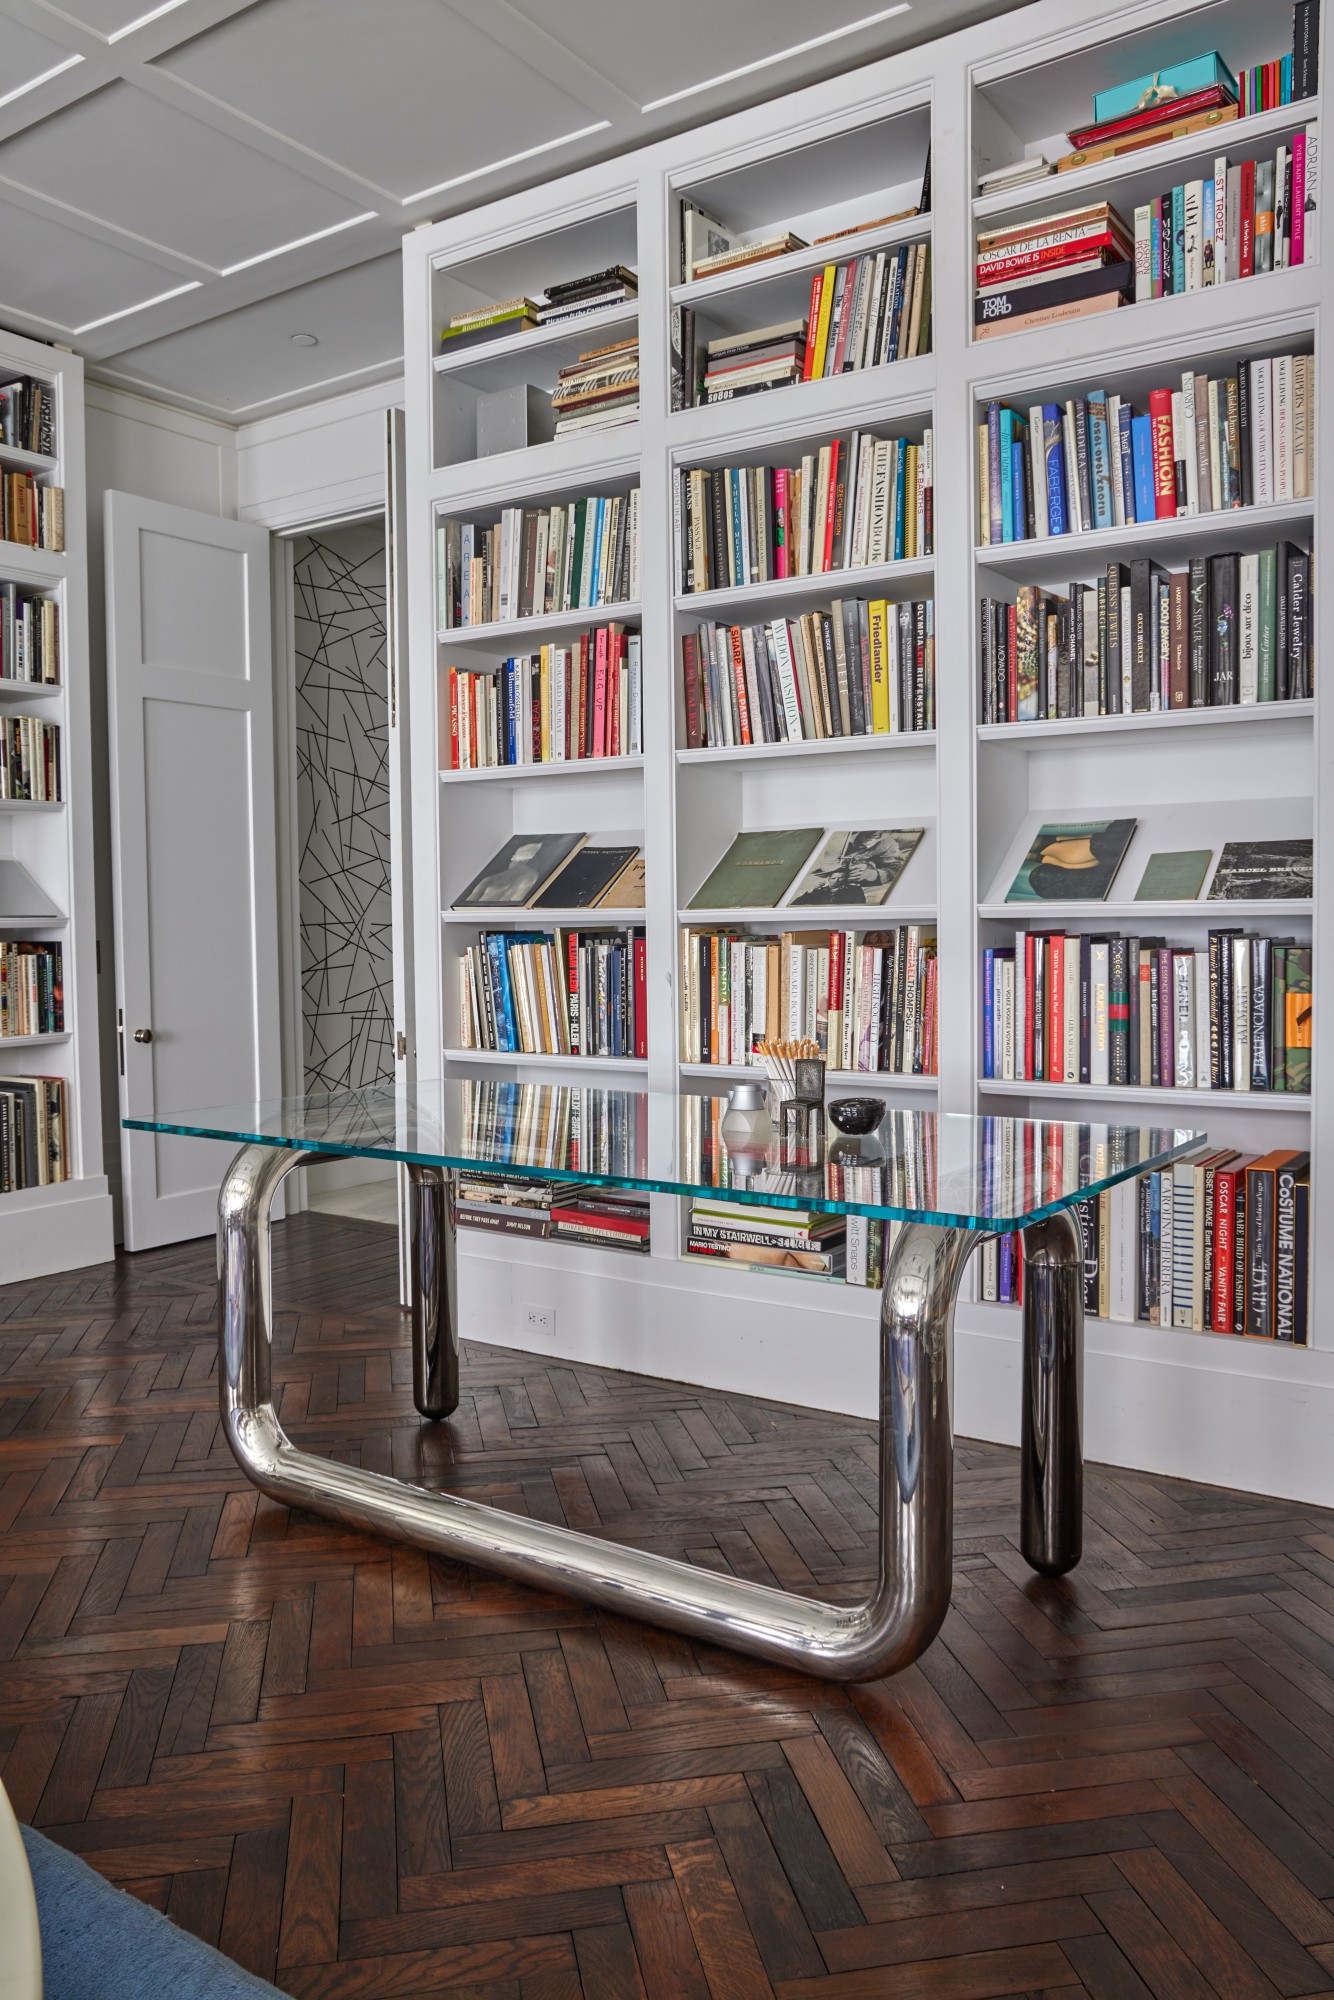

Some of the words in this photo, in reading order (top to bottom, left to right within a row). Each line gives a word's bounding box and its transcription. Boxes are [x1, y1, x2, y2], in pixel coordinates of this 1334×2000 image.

[1306, 136, 1318, 192] ADRIAN
[1216, 178, 1224, 195] ST.
[1216, 196, 1224, 242] TROPEZ
[979, 261, 1005, 275] DAVID
[1005, 255, 1032, 269] BOWIE
[1032, 252, 1040, 262] IS
[1040, 245, 1066, 259] INSIDE
[982, 245, 1017, 262] OSCAR
[1019, 240, 1034, 253] DE
[1036, 235, 1049, 247] LA
[1052, 228, 1087, 244] RENTA
[1142, 239, 1150, 275] FASHION
[843, 282, 851, 303] Tazio
[893, 268, 903, 309] REVELATION
[982, 295, 1007, 310] TOM
[838, 302, 850, 343] Secchiaroli
[983, 303, 1012, 319] FORD
[1024, 314, 1051, 326] Christian
[1185, 377, 1194, 419] CARVEN
[1295, 358, 1305, 408] HARPER'S
[1033, 416, 1041, 434] Cartier
[1075, 411, 1087, 469] VERDURA
[1111, 425, 1119, 439] ART
[1120, 430, 1131, 455] PIAGET
[1294, 411, 1305, 456] BAZAAR
[878, 444, 887, 470] THE
[1112, 440, 1121, 464] DECO
[1158, 415, 1174, 497] FASHION
[874, 471, 886, 525] FASHION
[1047, 458, 1062, 527] FABERGE
[1097, 477, 1106, 516] BIJOUX
[1113, 466, 1122, 499] JEWELRY
[835, 510, 843, 536] VISION
[716, 528, 724, 581] REVELATIONS
[872, 526, 883, 563] BOOK
[463, 534, 471, 599] AREA
[581, 552, 589, 598] HOLLYWOOD
[1160, 597, 1170, 624] body
[1243, 593, 1252, 615] déco
[1292, 573, 1303, 613] Calder
[1108, 612, 1118, 648] JEWELS
[1192, 607, 1204, 643] SILVER
[1244, 615, 1252, 630] ART
[1290, 615, 1303, 660] Jewelry
[731, 629, 742, 664] SHARP
[872, 614, 883, 684] Friedlander
[1160, 625, 1170, 660] jewelry
[1243, 633, 1254, 660] bijoux
[686, 646, 695, 685] RALPH
[735, 666, 746, 697] NIGEL
[837, 653, 849, 696] SIEFF
[997, 645, 1006, 682] MOVADO
[1213, 671, 1234, 682] JAR
[688, 690, 698, 736] LAUREN
[737, 698, 749, 732] PARRY
[781, 675, 798, 725] FASHION
[916, 667, 924, 731] RIEFENSTAHL
[450, 704, 458, 737] PICASSO
[532, 699, 541, 755] DOISNEAU
[568, 933, 578, 968] WILLIAM
[907, 937, 916, 981] MICHAEL
[569, 970, 578, 993] KLEIN
[720, 966, 728, 1003] INDIA
[791, 950, 799, 999] EDOUARD
[570, 993, 580, 1046] PARIS+KLEIN
[790, 1000, 798, 1040] BOUBAT
[871, 1001, 880, 1044] SOCIETY
[905, 979, 915, 1033] THOMPSON
[1237, 984, 1248, 1045] BALMAIN
[1253, 985, 1265, 1068] BALENCIAGA
[1205, 1171, 1213, 1195] ISSEY
[1218, 1181, 1229, 1214] OSCAR
[850, 1216, 861, 1237] witt
[1079, 1199, 1093, 1248] istian
[1161, 1177, 1172, 1240] CAROLINA
[1205, 1195, 1213, 1227] MIYAKE
[1236, 1211, 1244, 1236] RARE
[1277, 1174, 1294, 1250] CoSTUME
[561, 1223, 585, 1232] ROBERT
[693, 1225, 702, 1236] IN
[703, 1227, 718, 1238] MY
[719, 1230, 772, 1246] STAIRWELL
[1204, 1230, 1212, 1246] East
[1218, 1218, 1228, 1250] NIGHT
[689, 1240, 708, 1248] MARIO
[707, 1242, 732, 1252] TESTINO
[850, 1238, 861, 1270] Snaps
[1204, 1247, 1212, 1270] Meets
[1236, 1237, 1244, 1260] BIRD
[1084, 1257, 1098, 1305] Dior
[1161, 1244, 1172, 1296] HERRERA
[1204, 1271, 1212, 1291] West
[1217, 1266, 1227, 1299] VANITY
[1235, 1274, 1244, 1312] FASHION
[1277, 1254, 1293, 1337] NATIONAL
[1217, 1301, 1227, 1322] FAIR
